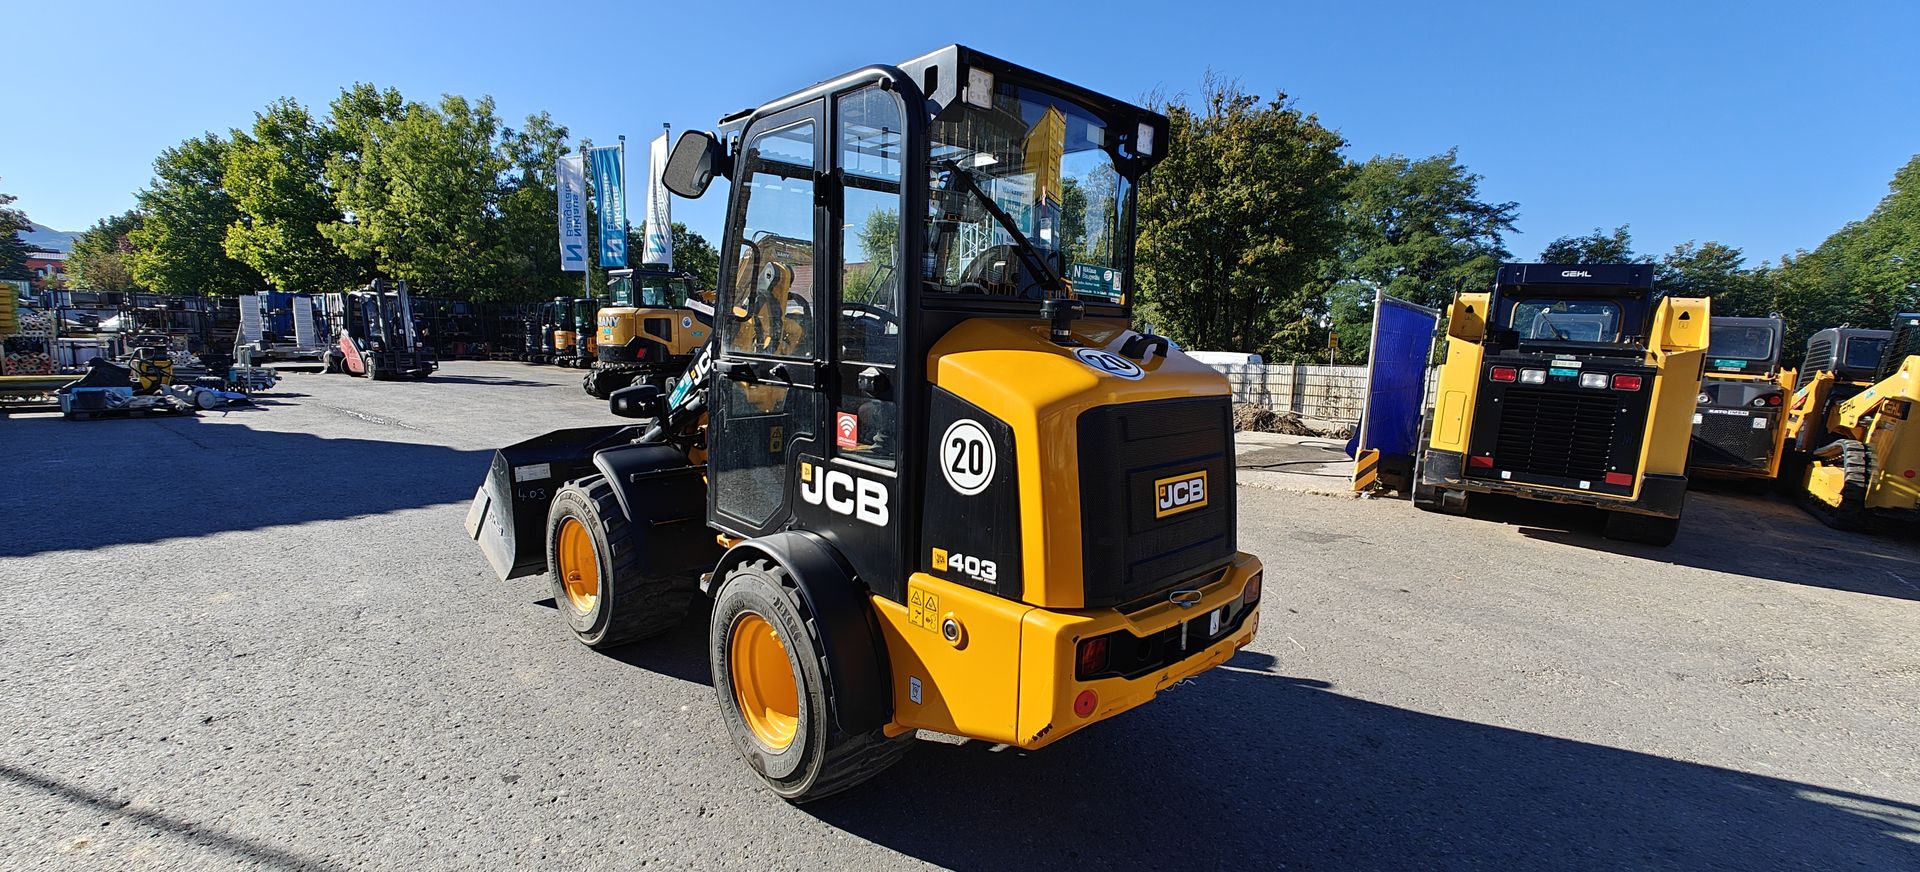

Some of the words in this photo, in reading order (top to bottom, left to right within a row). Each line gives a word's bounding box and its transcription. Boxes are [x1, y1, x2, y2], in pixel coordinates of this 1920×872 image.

[1074, 265, 1081, 278] N
[1561, 270, 1592, 278] GEHL
[1085, 353, 1132, 371] 20
[951, 437, 984, 476] 20
[518, 487, 547, 502] 403
[801, 465, 889, 527] JCB
[1160, 478, 1204, 509] JCB
[948, 553, 997, 581] 403
